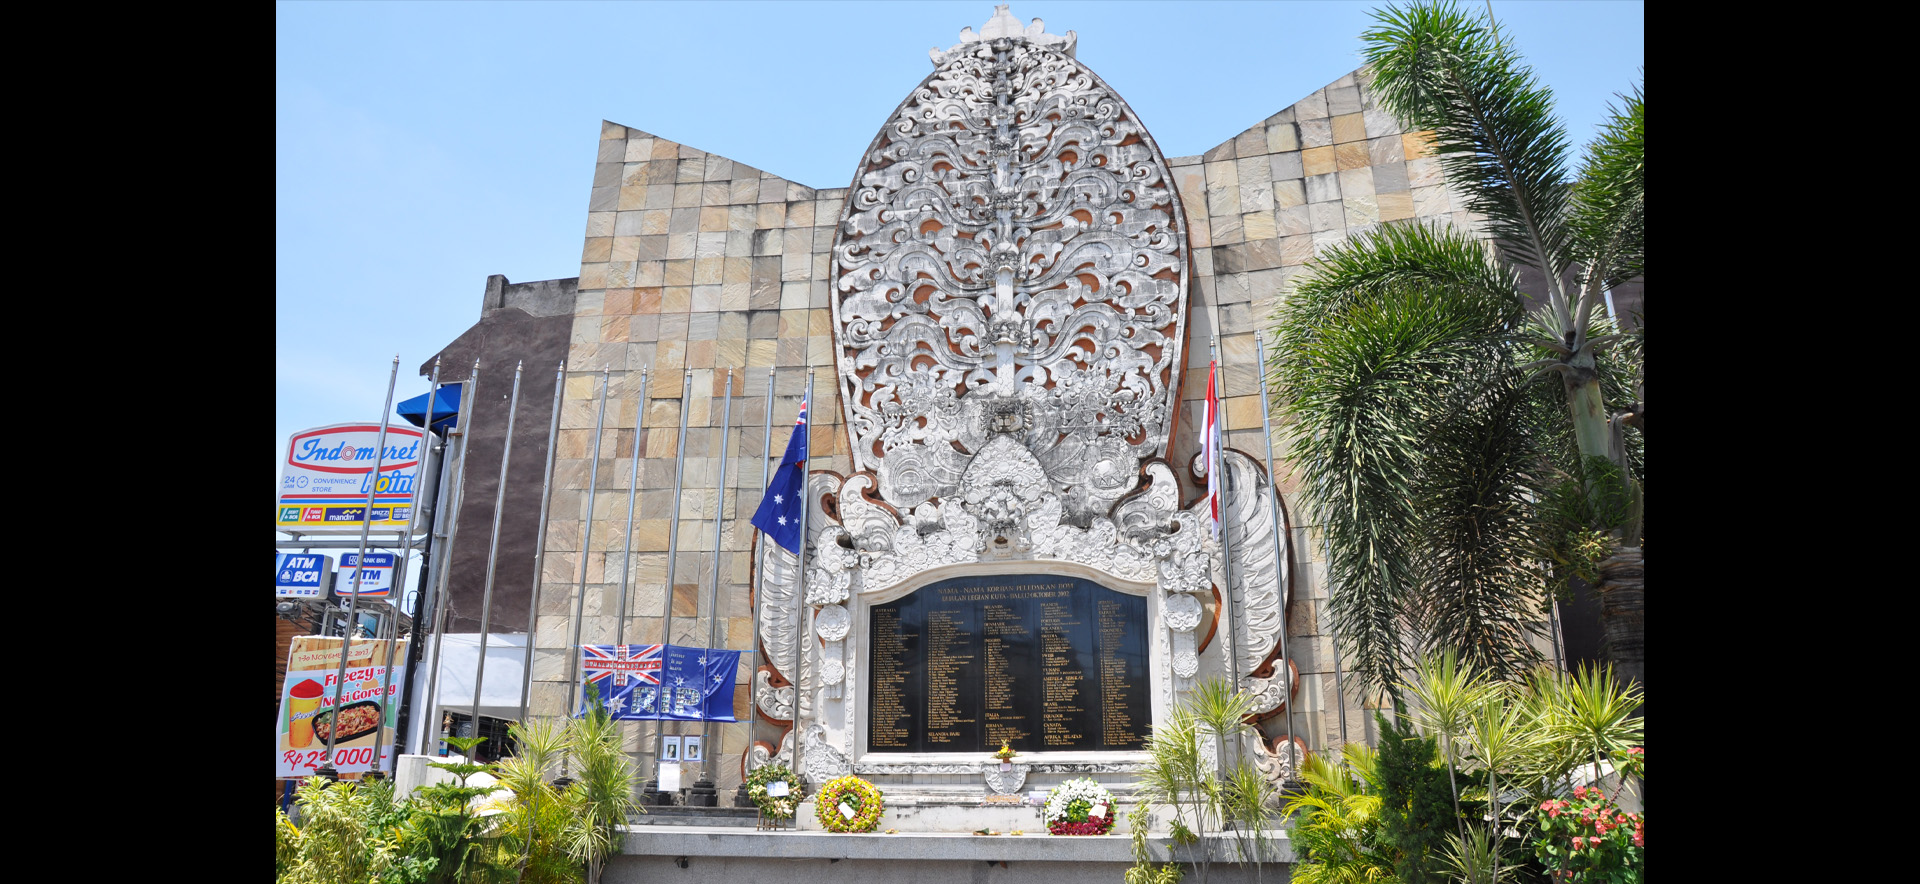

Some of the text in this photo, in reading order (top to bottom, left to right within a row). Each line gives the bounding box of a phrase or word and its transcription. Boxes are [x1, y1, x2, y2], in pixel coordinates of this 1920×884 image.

[284, 475, 295, 484] 24
[329, 513, 355, 521] mandiri
[286, 557, 316, 569] ATM
[292, 570, 319, 583] BCA
[311, 651, 353, 660] NOVEMBR
[352, 684, 396, 701] Goreg
[630, 686, 701, 714] RIP
[283, 749, 304, 771] Rp
